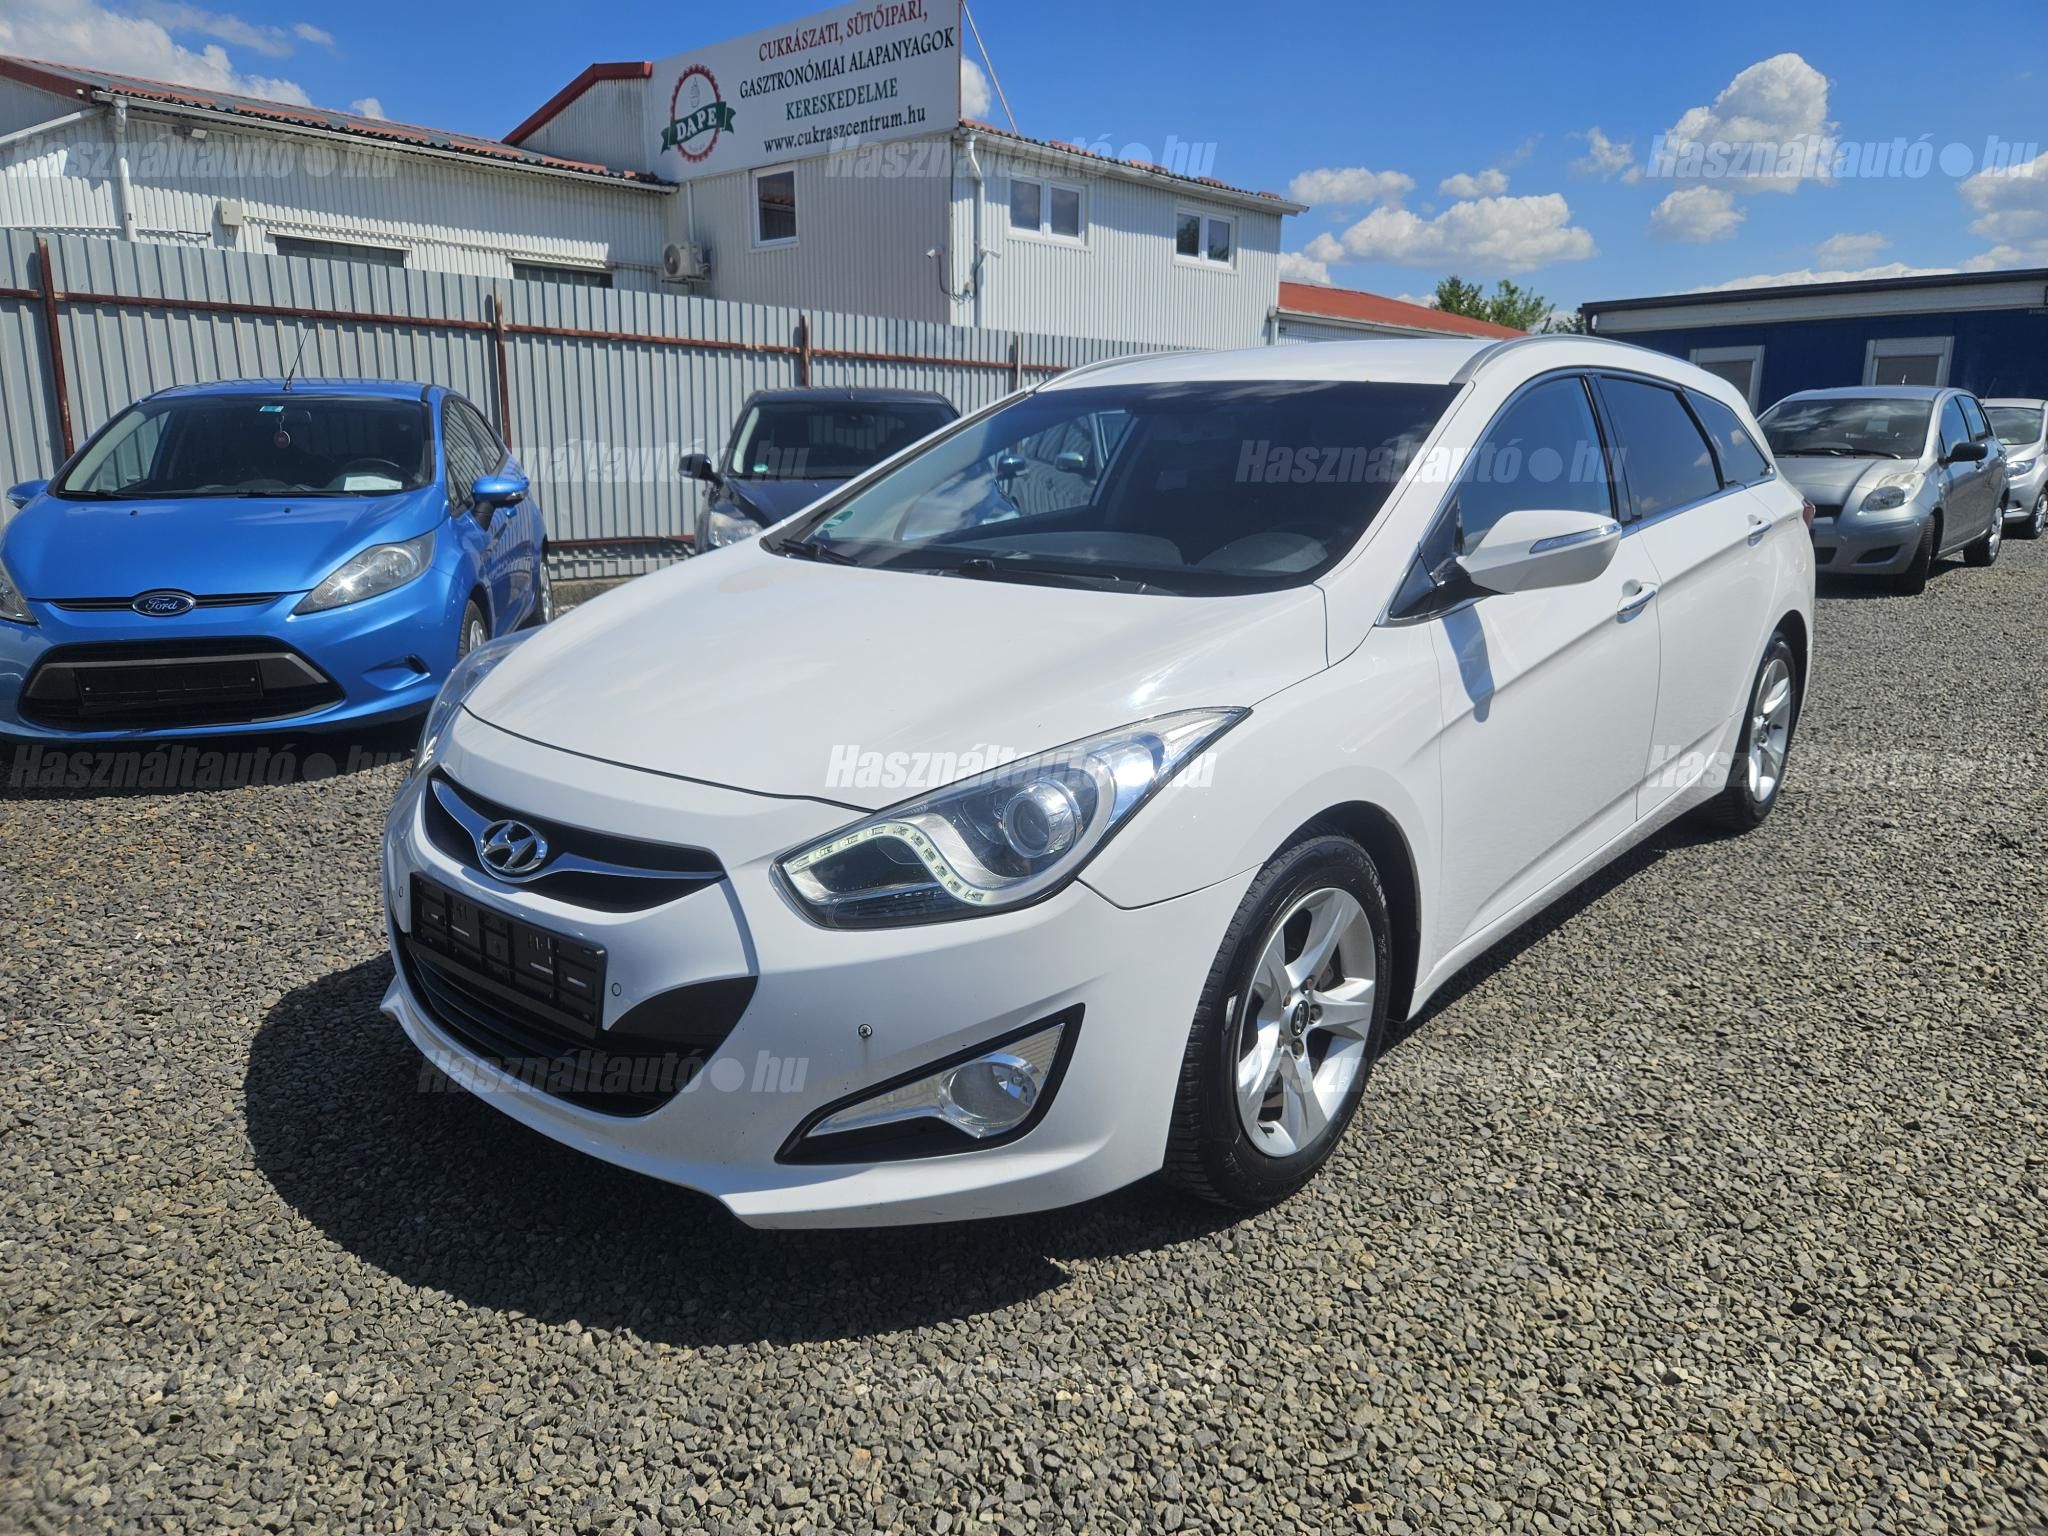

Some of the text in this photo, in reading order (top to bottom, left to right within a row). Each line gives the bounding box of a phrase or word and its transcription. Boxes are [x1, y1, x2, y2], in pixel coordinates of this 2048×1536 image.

[740, 27, 955, 99] GASZTRONÓMIAI ALAPANYAGOK
[759, 22, 844, 62] CUKRÁSZATI,
[786, 77, 898, 121] KERESKEDELME
[676, 107, 718, 142] DAPE
[764, 105, 926, 153] www.cukraszcentrum.hu
[145, 597, 179, 611] Ford
